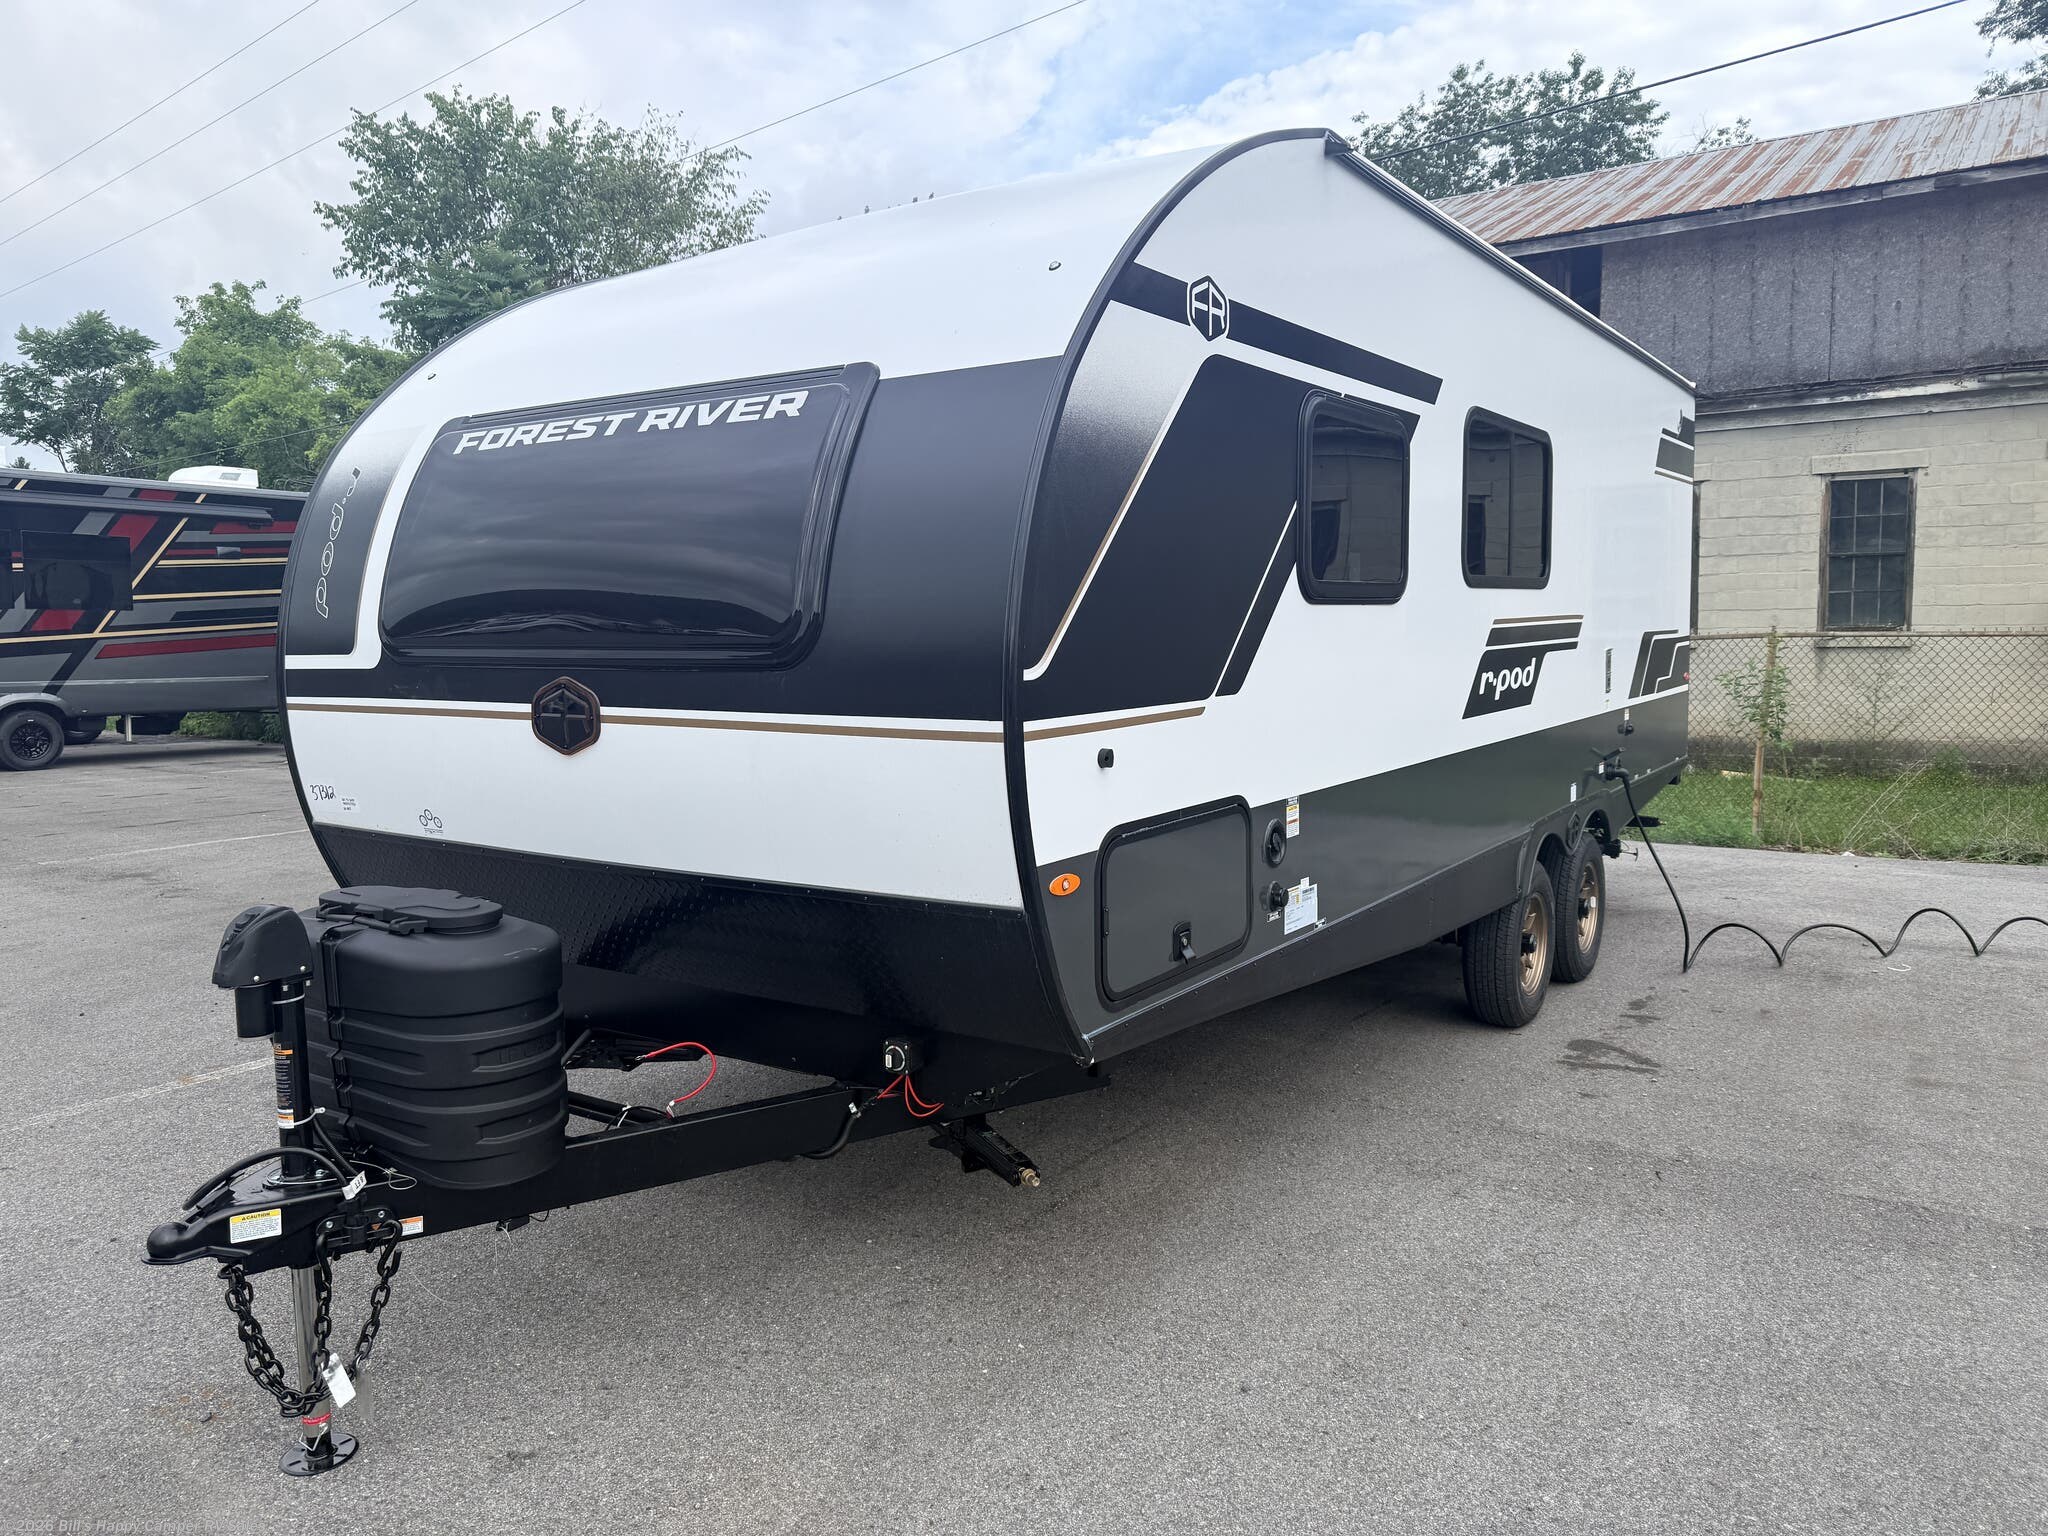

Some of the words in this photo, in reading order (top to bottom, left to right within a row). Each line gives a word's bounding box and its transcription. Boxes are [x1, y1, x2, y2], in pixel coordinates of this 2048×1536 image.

[453, 412, 638, 455] FOREST
[637, 390, 809, 432] RIVER
[246, 1211, 271, 1221] CAUTION
